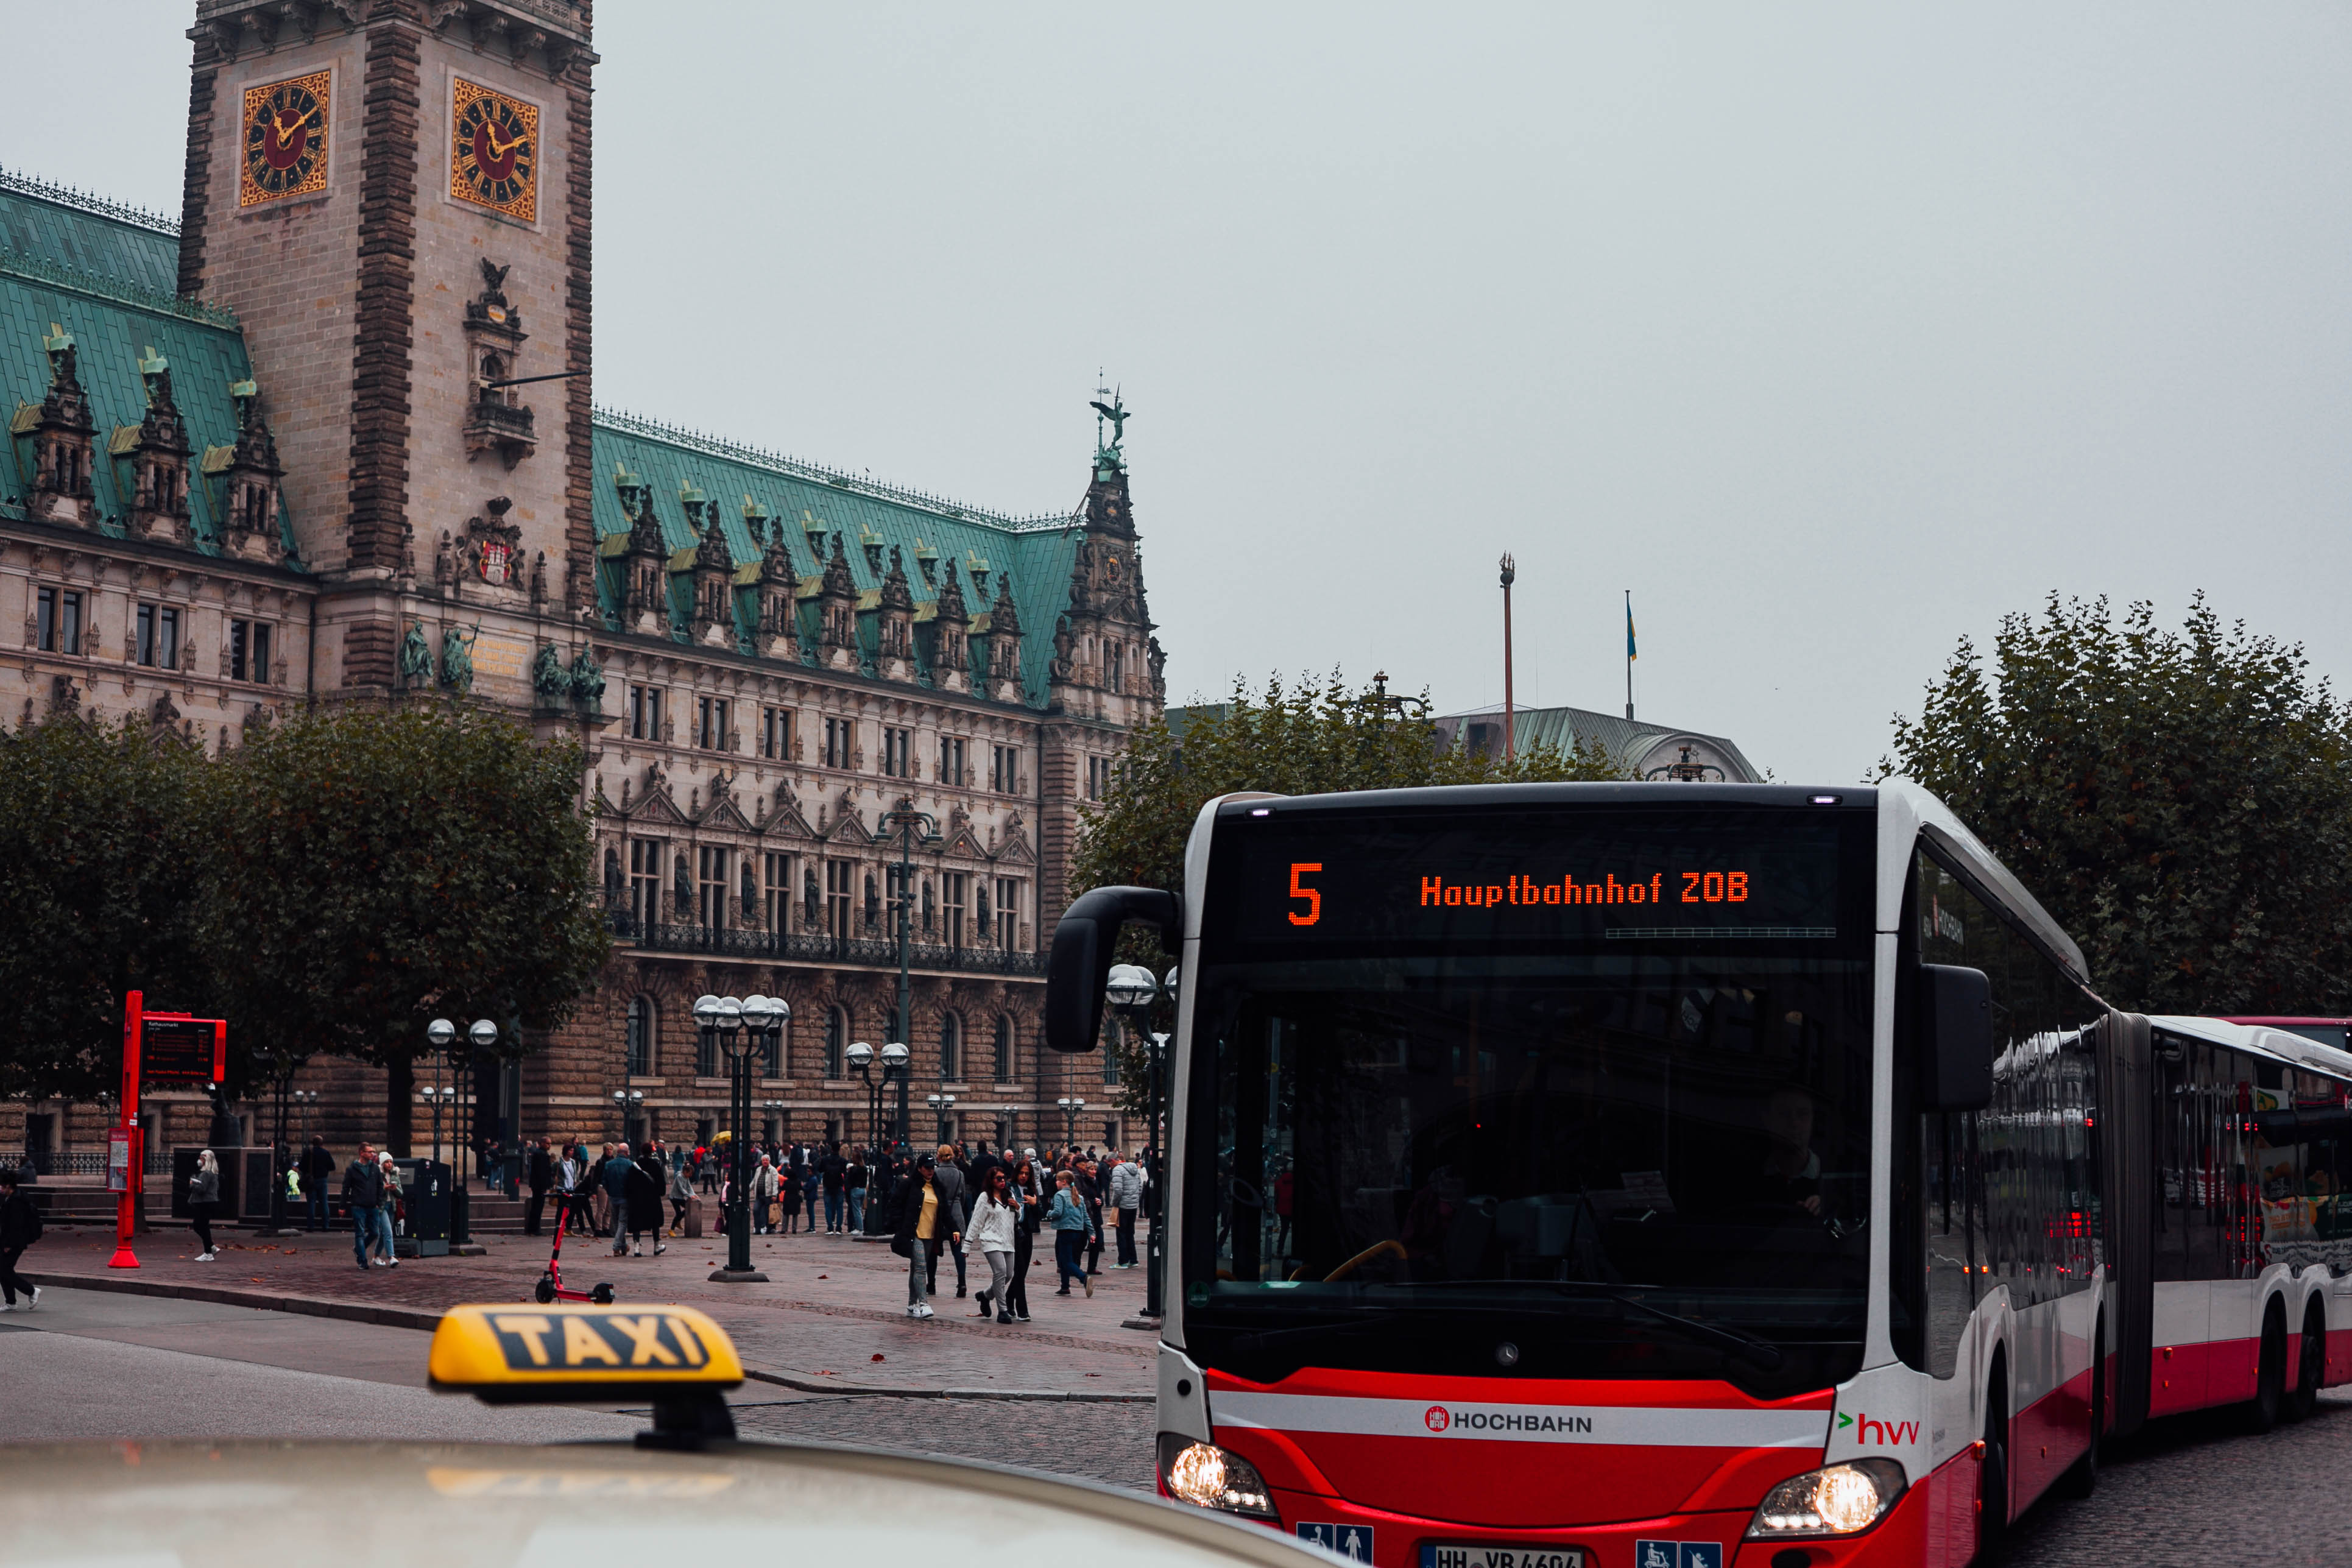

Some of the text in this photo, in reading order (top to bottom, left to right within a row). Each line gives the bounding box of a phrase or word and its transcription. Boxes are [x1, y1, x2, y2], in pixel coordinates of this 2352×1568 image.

[1288, 863, 1322, 925] 5
[1421, 871, 1748, 908] Hauptbahnhof ZOB
[493, 1314, 705, 1366] TAXI
[1454, 1413, 1592, 1433] HOCHBAHN
[1438, 1550, 1467, 1568] HH
